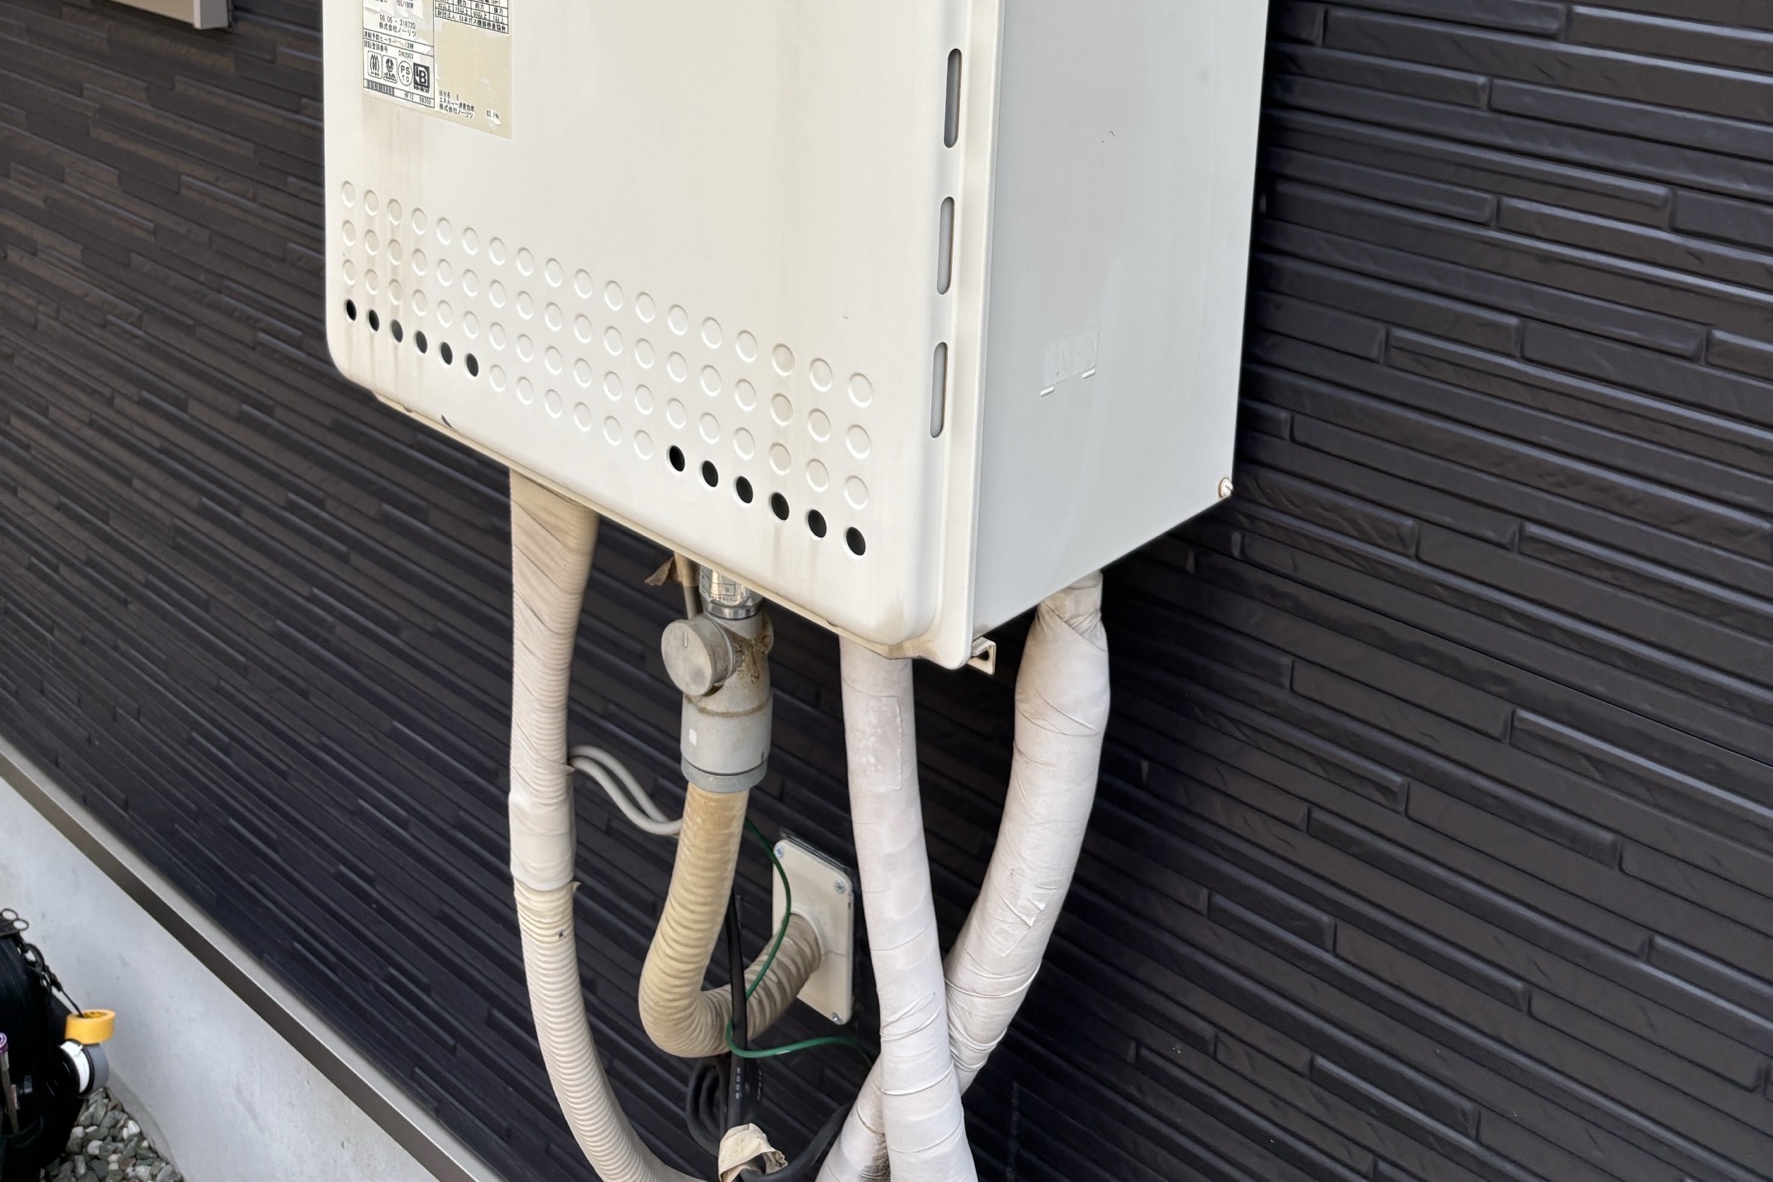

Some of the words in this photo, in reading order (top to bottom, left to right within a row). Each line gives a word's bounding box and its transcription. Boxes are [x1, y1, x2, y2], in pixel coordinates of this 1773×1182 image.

[378, 21, 417, 38] 株式会社ノーリツ
